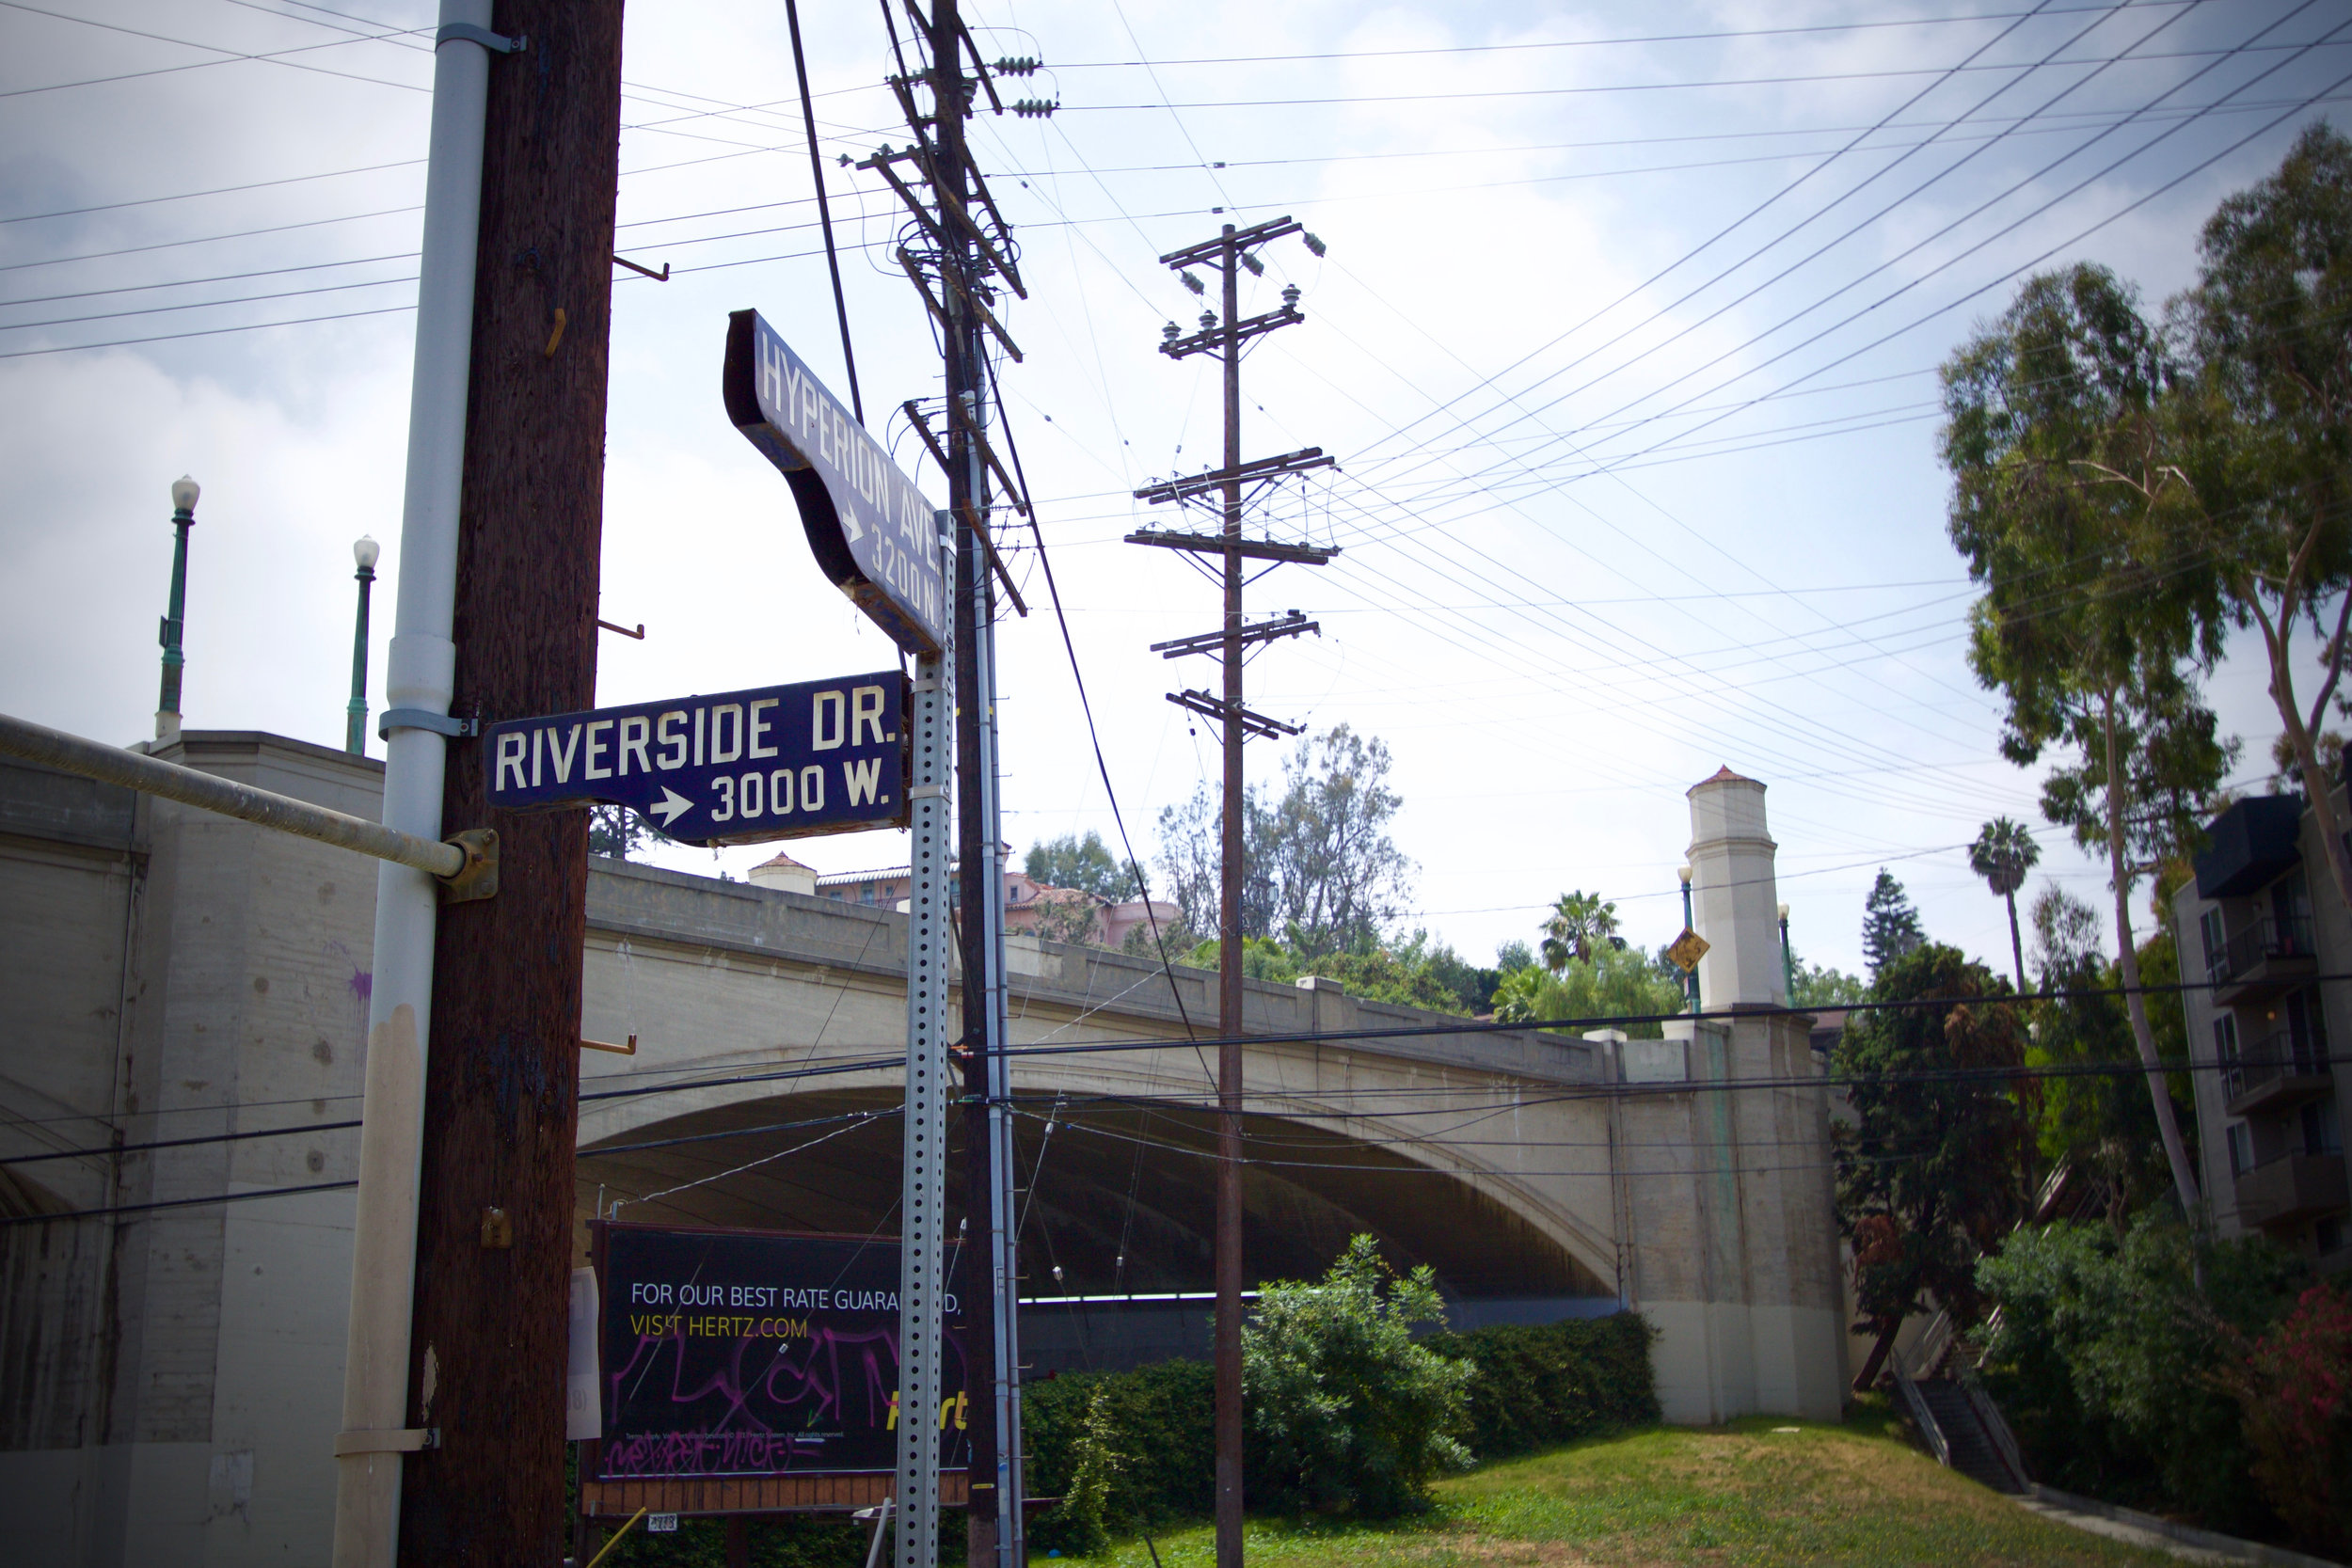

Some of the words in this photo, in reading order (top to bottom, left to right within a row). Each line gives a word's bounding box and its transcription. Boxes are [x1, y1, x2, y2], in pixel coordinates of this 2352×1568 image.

[763, 331, 890, 523] HYPERION
[900, 484, 941, 577] AVE.
[871, 522, 921, 610] 3200
[924, 574, 939, 629] N.
[496, 698, 779, 792] RIVERSIDE
[812, 685, 897, 752] DR.
[711, 764, 825, 822] 3000
[843, 757, 889, 807] W.
[629, 1314, 683, 1336] VISIT
[689, 1316, 808, 1338] HERTZ.COM
[632, 1283, 673, 1305] FOR
[679, 1284, 723, 1306] OUR
[731, 1286, 778, 1307] BEST
[784, 1288, 829, 1309] RATE
[834, 1290, 961, 1315] GUARAD,
